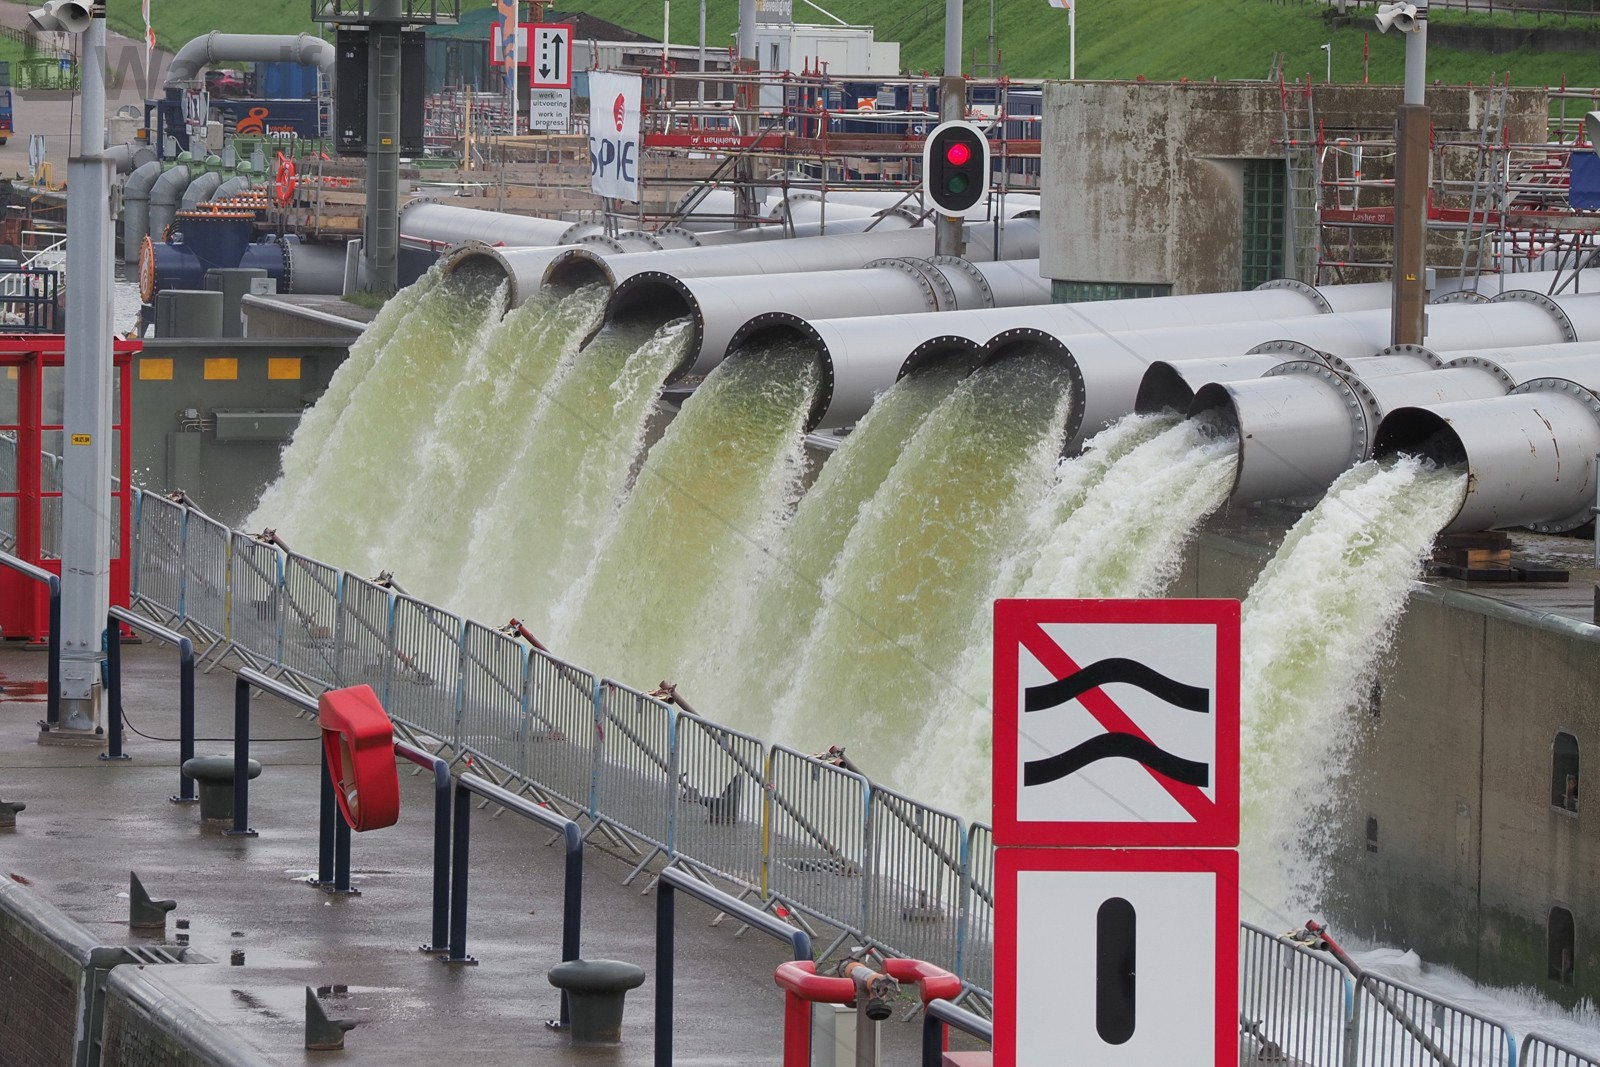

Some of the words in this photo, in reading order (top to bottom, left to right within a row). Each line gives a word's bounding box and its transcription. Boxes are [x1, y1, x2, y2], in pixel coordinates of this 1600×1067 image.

[533, 100, 567, 108] uitvoering
[703, 137, 741, 145] Muehlhan
[589, 137, 635, 182] SPIE
[1352, 212, 1376, 222] Layher
